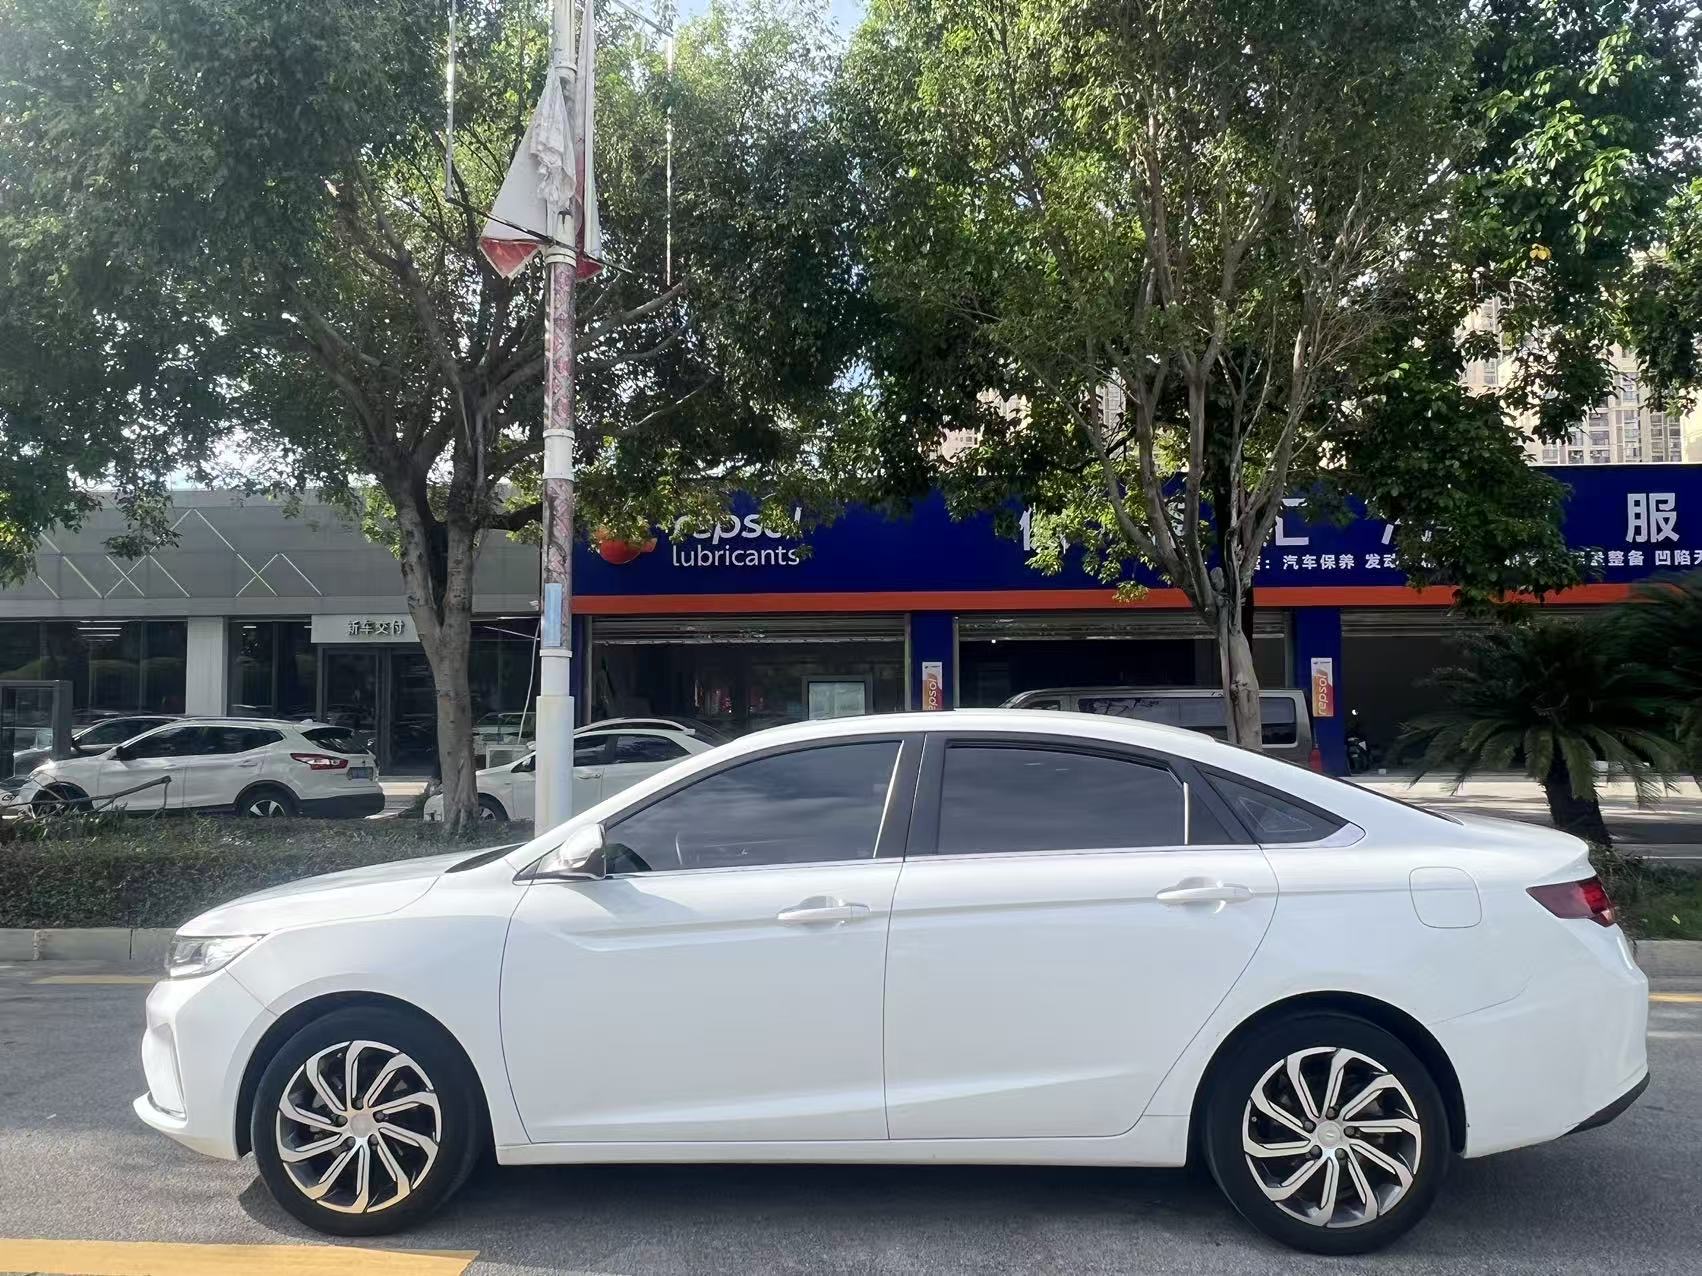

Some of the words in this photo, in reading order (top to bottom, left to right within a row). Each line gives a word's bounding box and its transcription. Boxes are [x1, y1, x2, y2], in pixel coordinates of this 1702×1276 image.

[670, 506, 802, 545] rpsl
[1625, 492, 1680, 543] 服
[672, 544, 800, 567] lubricants
[347, 619, 405, 635] 新车交付
[1318, 672, 1329, 716] repsol
